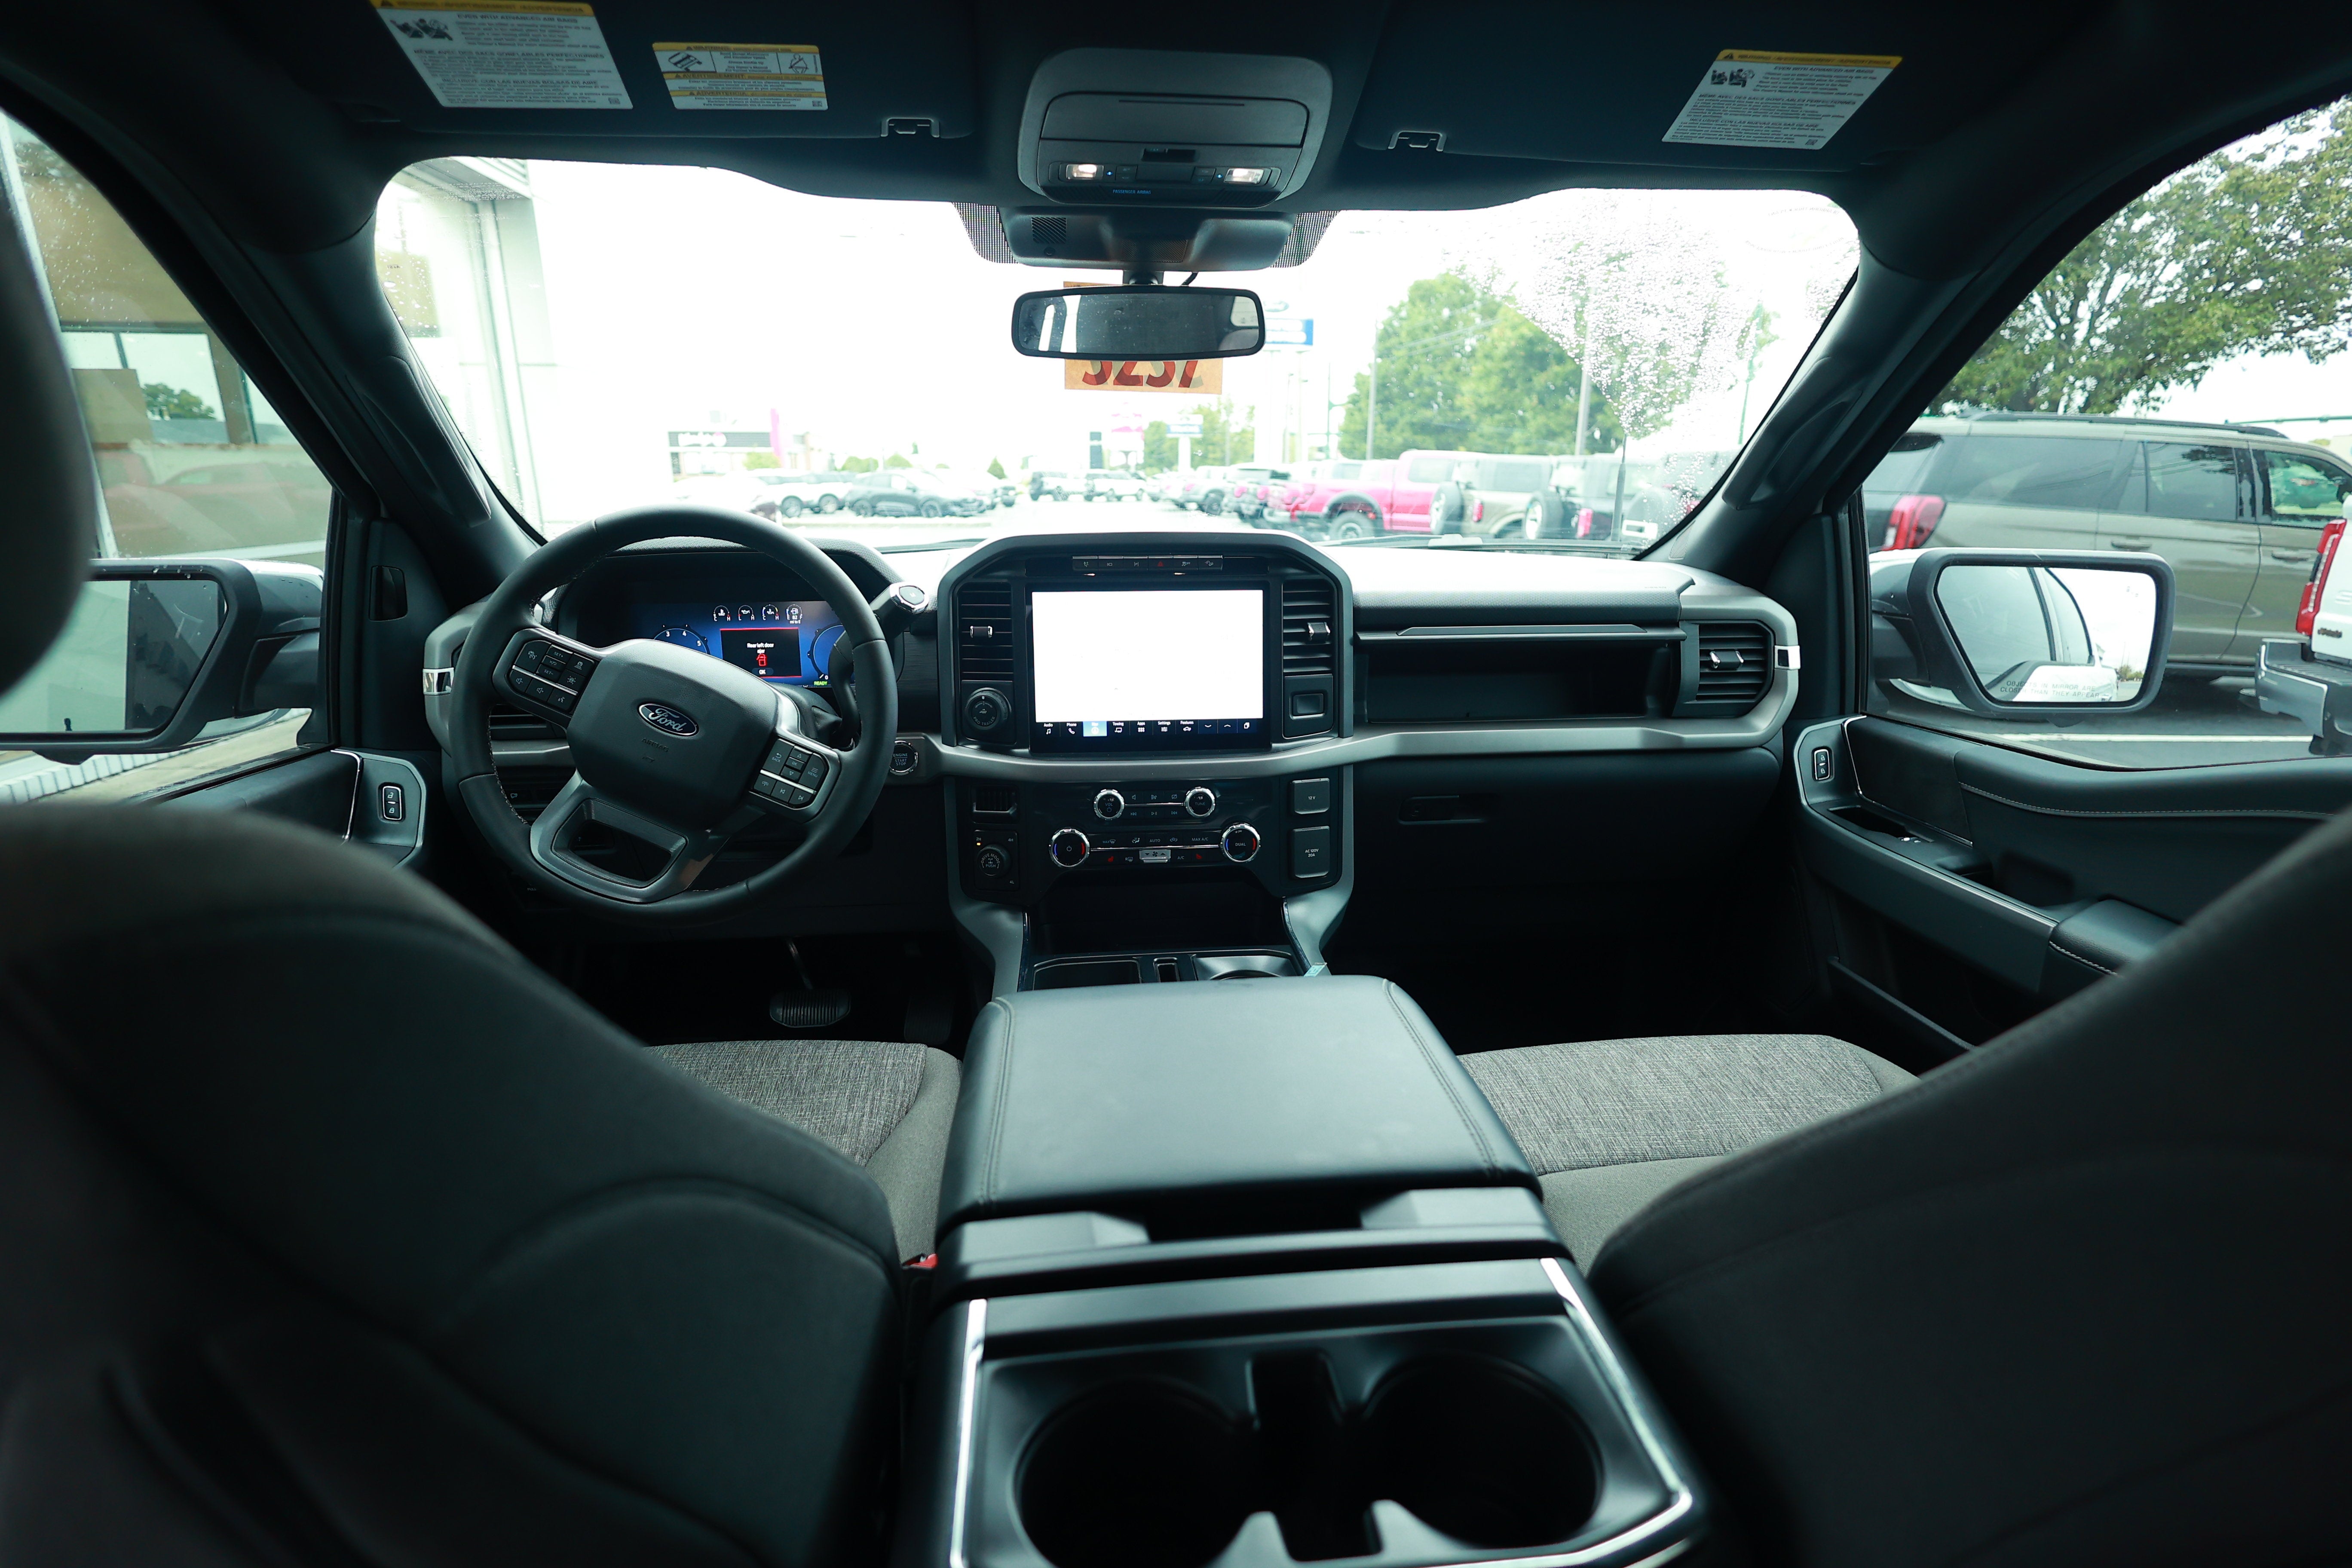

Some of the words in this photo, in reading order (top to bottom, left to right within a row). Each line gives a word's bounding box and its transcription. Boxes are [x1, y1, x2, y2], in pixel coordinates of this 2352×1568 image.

[648, 708, 687, 731] Ford
[982, 716, 995, 726] TRAILER
[641, 738, 669, 753] AIRBAG
[980, 853, 990, 864] DRIVE
[991, 853, 1000, 864] MODE
